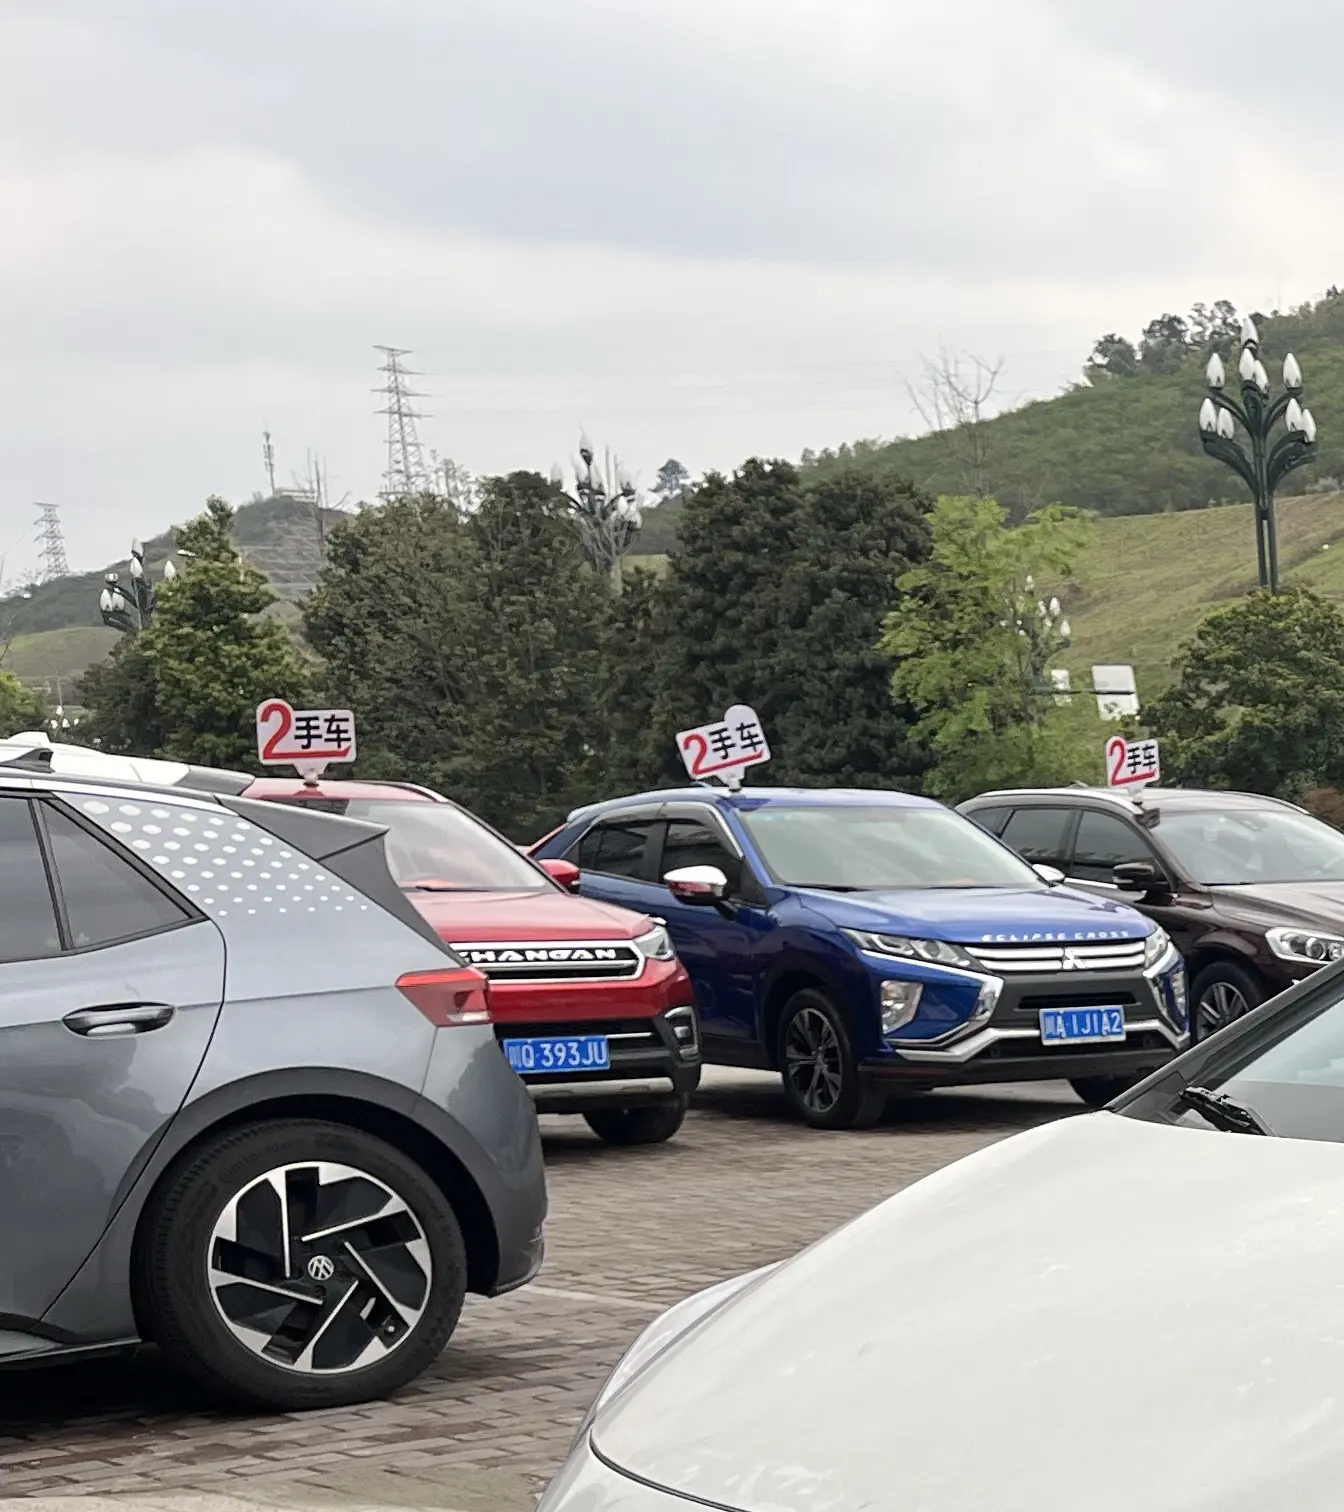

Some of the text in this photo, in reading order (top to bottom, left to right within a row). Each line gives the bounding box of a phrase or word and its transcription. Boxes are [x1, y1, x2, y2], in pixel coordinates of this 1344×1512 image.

[261, 704, 352, 760] 2手车
[683, 723, 764, 775] 2手车
[1109, 740, 1157, 786] 2手车
